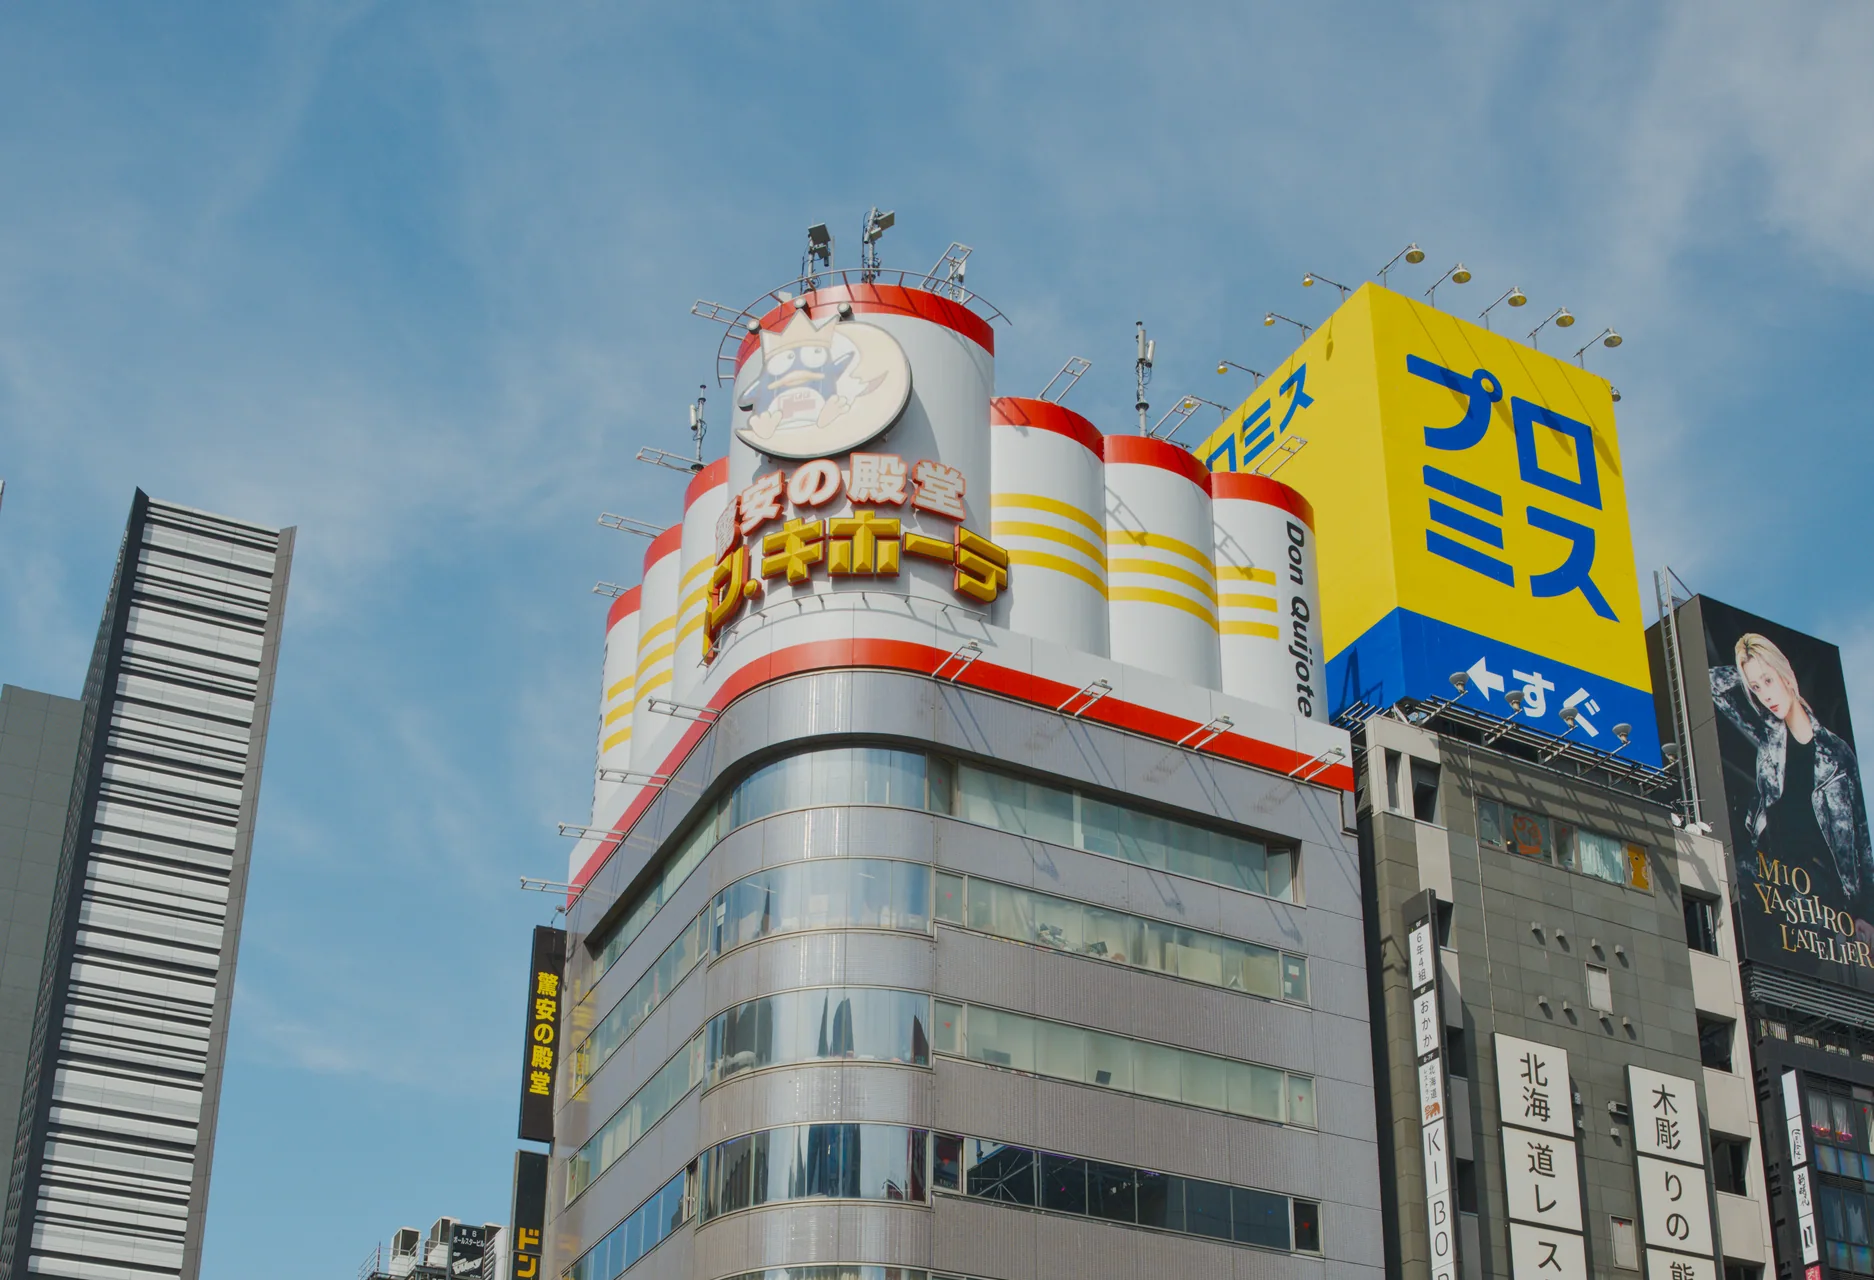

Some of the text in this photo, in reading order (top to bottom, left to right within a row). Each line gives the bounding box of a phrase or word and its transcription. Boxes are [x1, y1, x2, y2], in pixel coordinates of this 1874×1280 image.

[1406, 354, 1603, 511] プロ
[1423, 465, 1620, 623] ミス
[1286, 520, 1314, 719] Don Quijote
[1513, 669, 1601, 738] すぐ
[1754, 882, 1856, 937] YASHIRO
[1757, 851, 1811, 896] MIO
[529, 970, 558, 1096] 驚安の殿堂
[1420, 1000, 1433, 1048] おかか
